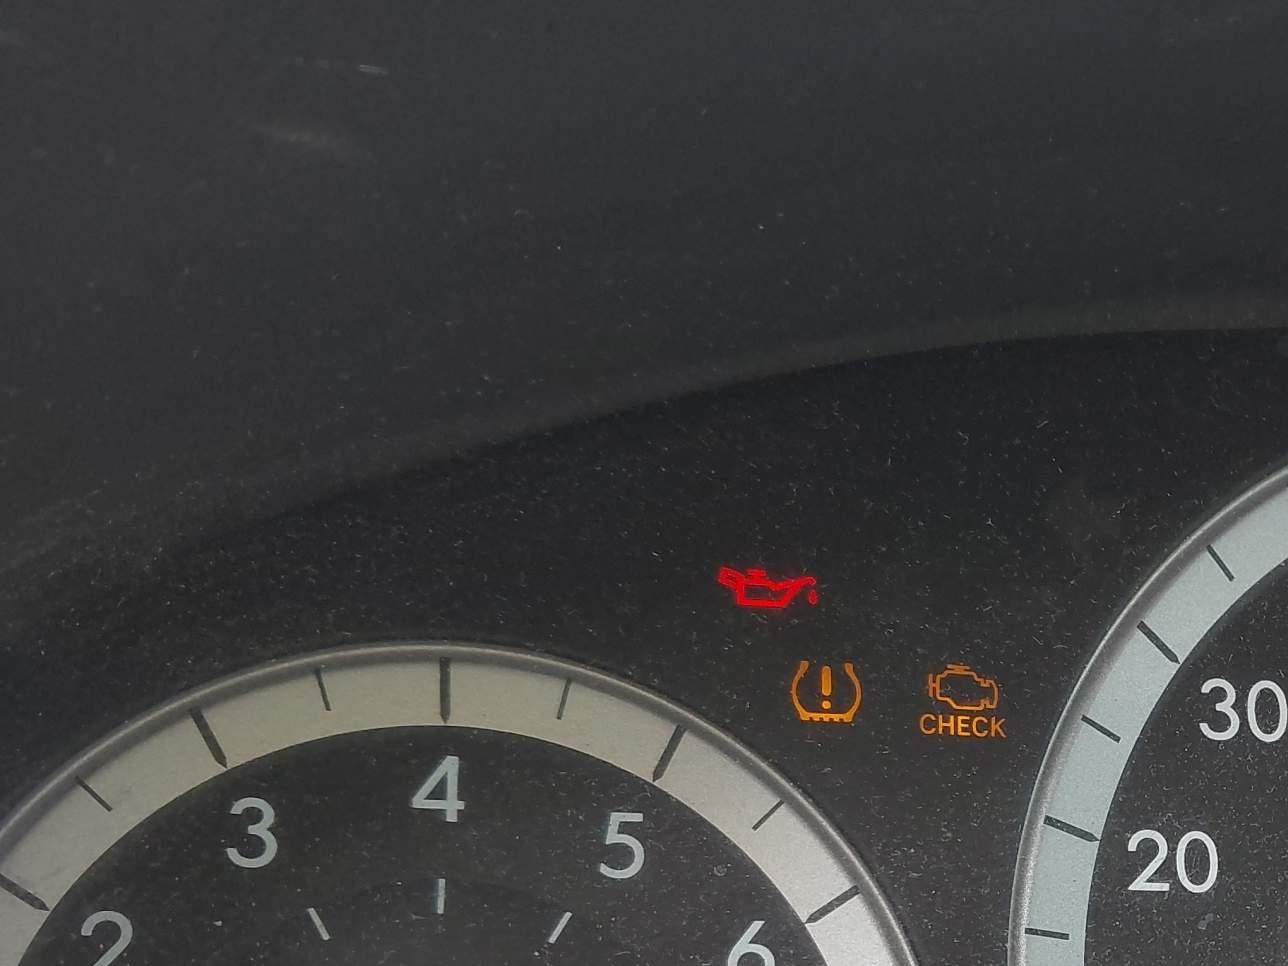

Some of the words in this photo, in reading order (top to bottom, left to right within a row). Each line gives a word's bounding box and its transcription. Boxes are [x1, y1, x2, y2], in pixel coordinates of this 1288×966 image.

[919, 713, 1006, 739] CHECK
[1200, 679, 1288, 742] 30
[411, 756, 465, 822] 4
[226, 797, 278, 869] 3
[599, 812, 645, 879] 5
[1126, 829, 1219, 893] 20
